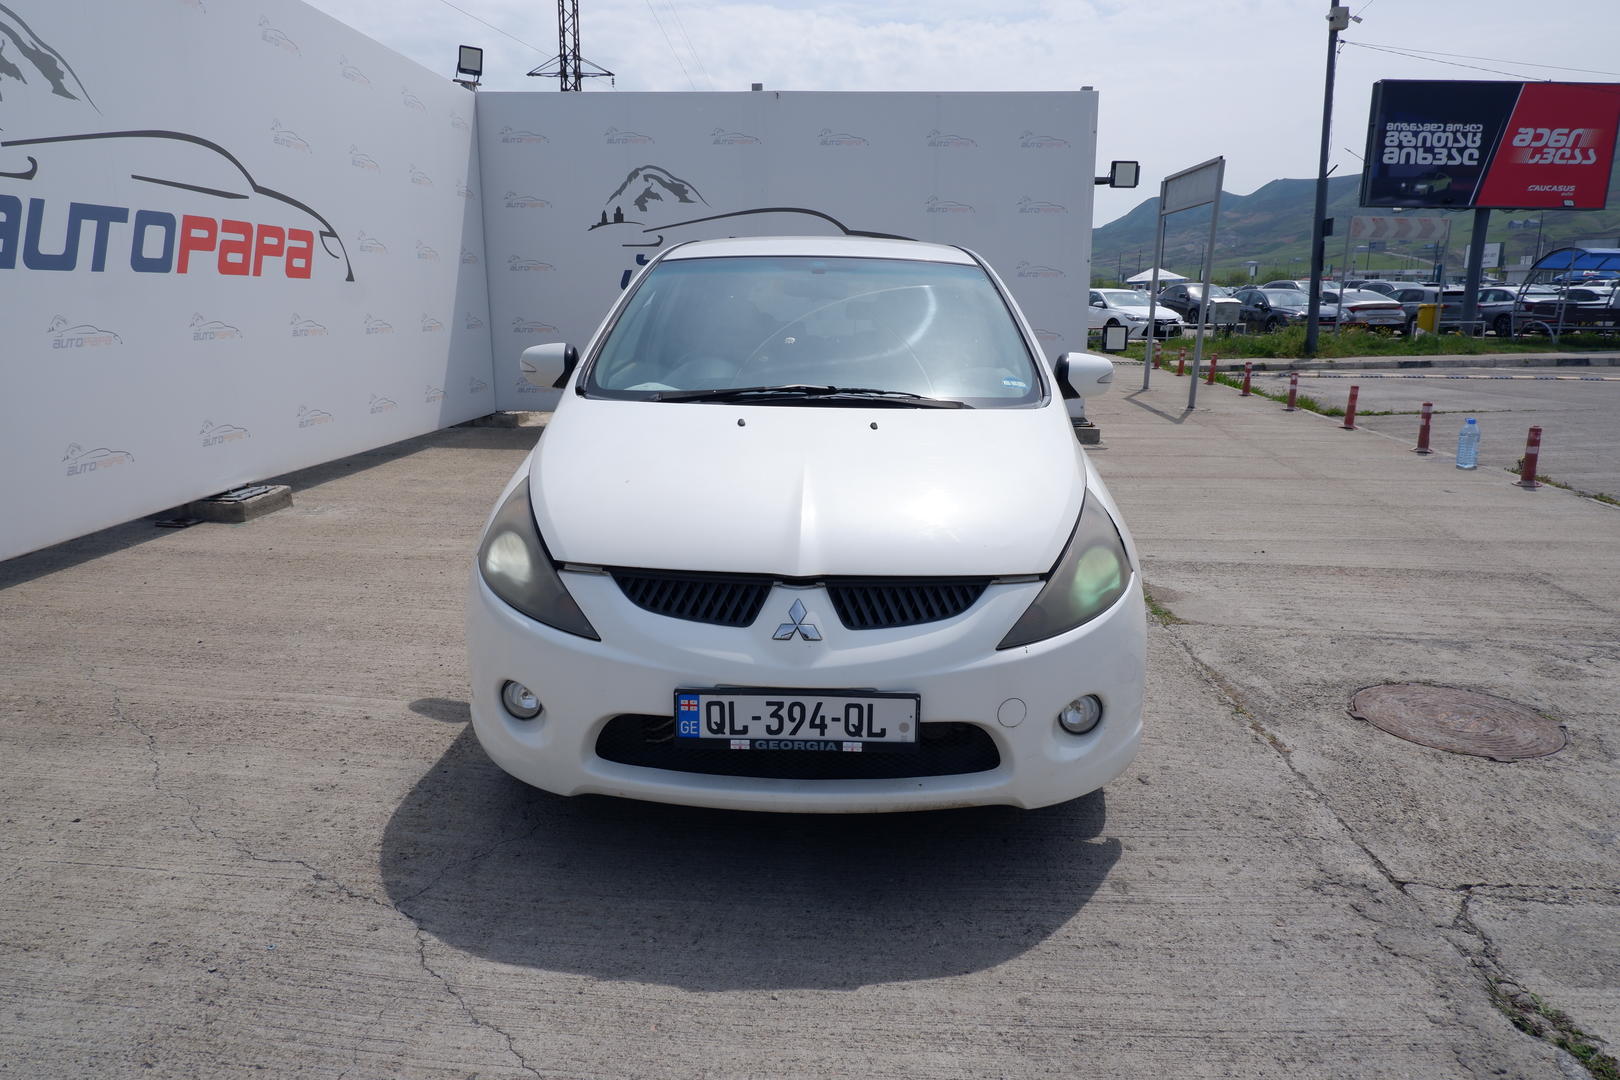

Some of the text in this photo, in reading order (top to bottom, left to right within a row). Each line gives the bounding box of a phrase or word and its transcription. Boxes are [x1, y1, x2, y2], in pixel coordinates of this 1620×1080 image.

[1382, 147, 1480, 165] მიხვალ
[705, 700, 887, 738] QL-394-QL
[680, 720, 699, 735] GE
[754, 740, 838, 752] GEORGIA
